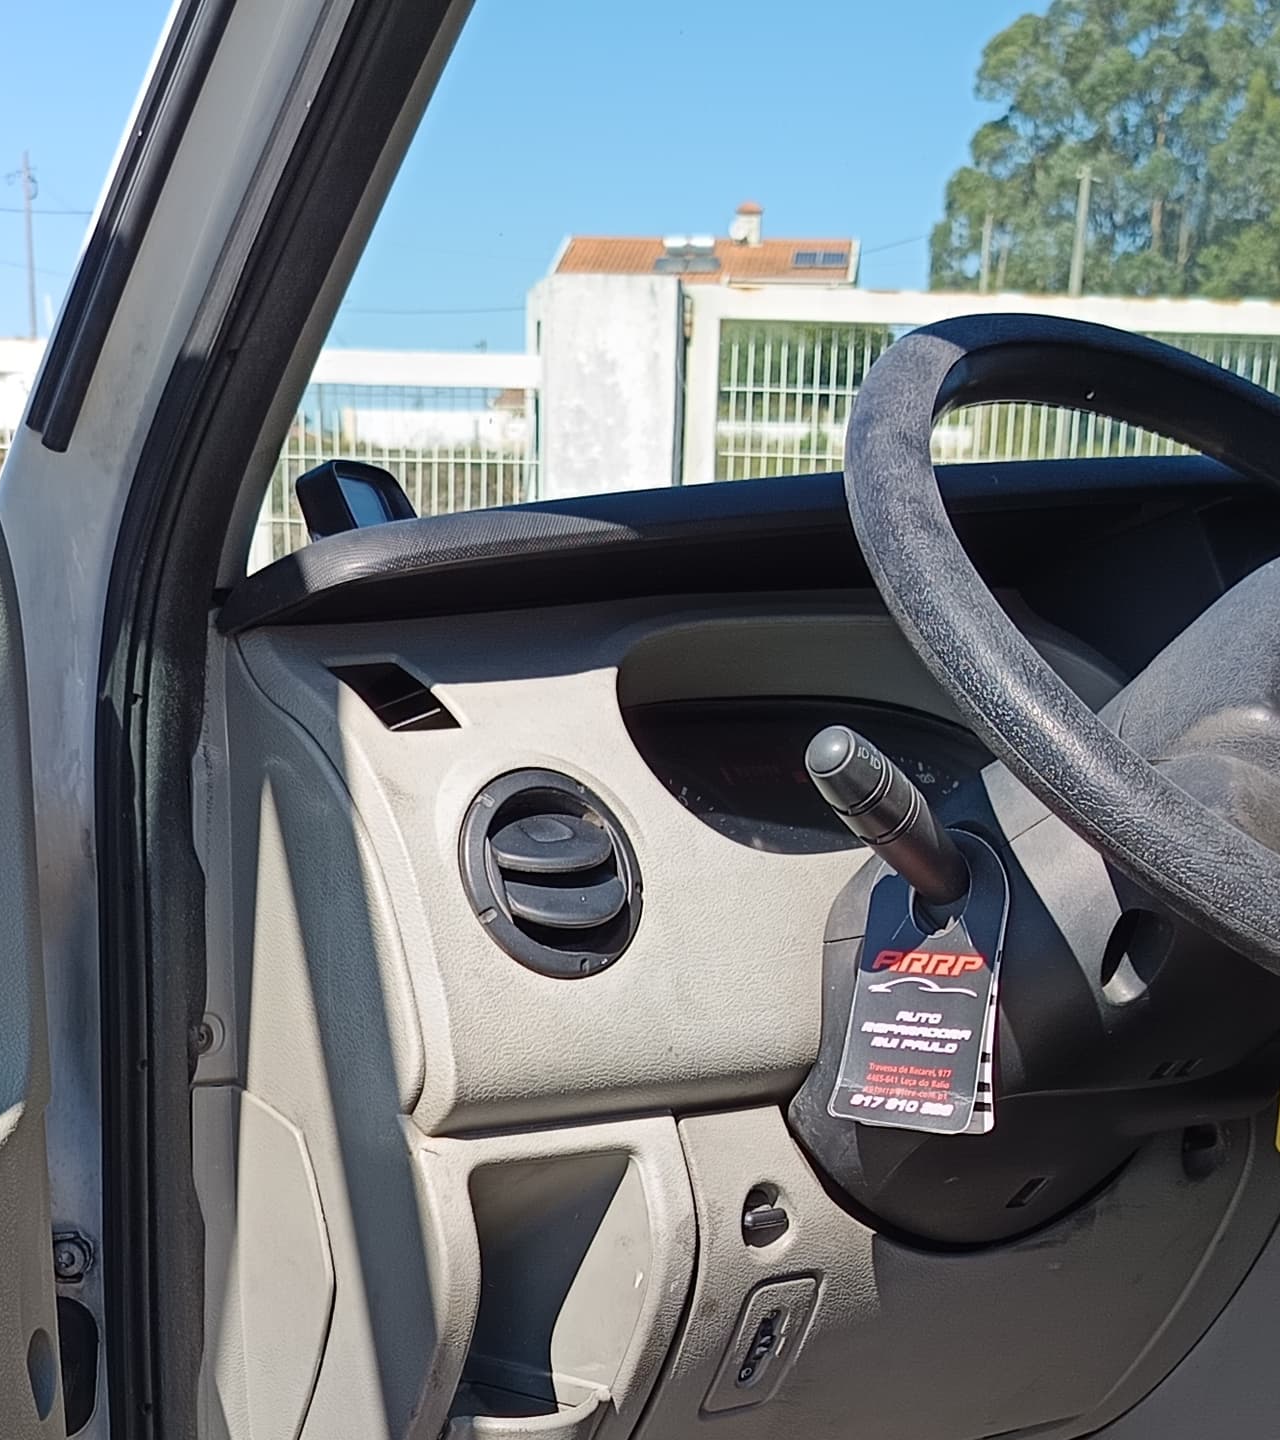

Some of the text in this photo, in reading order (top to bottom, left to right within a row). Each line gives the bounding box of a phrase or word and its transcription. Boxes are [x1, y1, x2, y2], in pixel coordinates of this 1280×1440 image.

[872, 950, 984, 976] ARRP
[895, 1011, 942, 1024] AUTO
[871, 1036, 958, 1053] RUI PAULO
[898, 1065, 908, 1074] de
[918, 1079, 929, 1087] do
